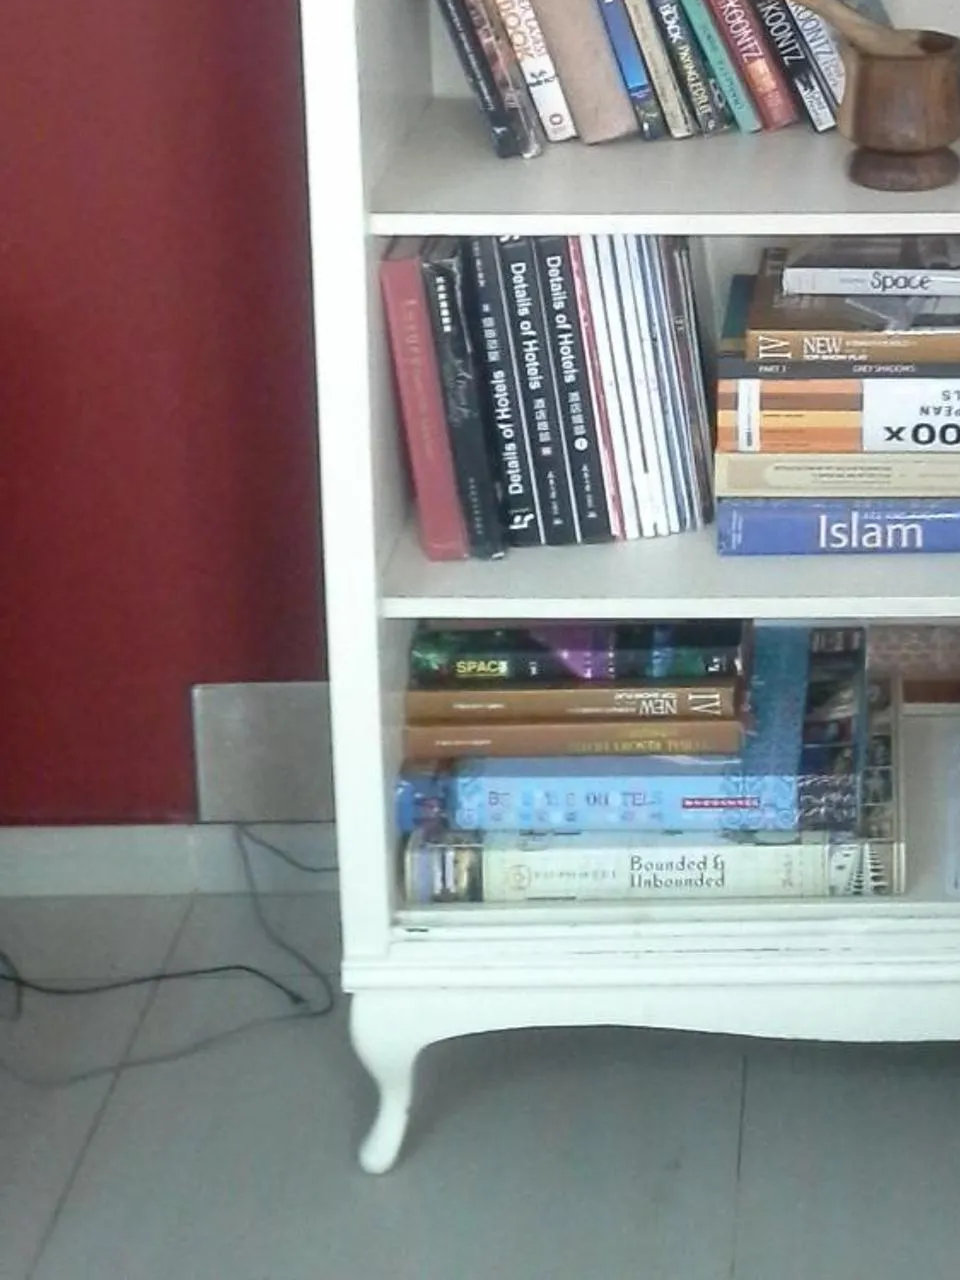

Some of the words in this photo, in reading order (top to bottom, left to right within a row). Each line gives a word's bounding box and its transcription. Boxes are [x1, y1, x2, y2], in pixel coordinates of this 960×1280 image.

[720, 0, 765, 63] KOONTZ
[760, 0, 806, 67] KOONTZ
[510, 262, 533, 317] Details
[545, 255, 568, 311] Details
[869, 271, 933, 293] Space
[519, 320, 537, 336] of
[554, 313, 573, 329] of
[521, 339, 544, 391] Hotels
[557, 333, 580, 384] Hotels
[802, 336, 843, 355] NEW
[489, 370, 513, 421] Hotels
[496, 422, 515, 440] of
[502, 442, 524, 496] Details
[818, 510, 924, 550] Islam
[637, 698, 678, 716] NEW
[630, 854, 708, 872] Bounded
[630, 870, 726, 889] Unbounded
